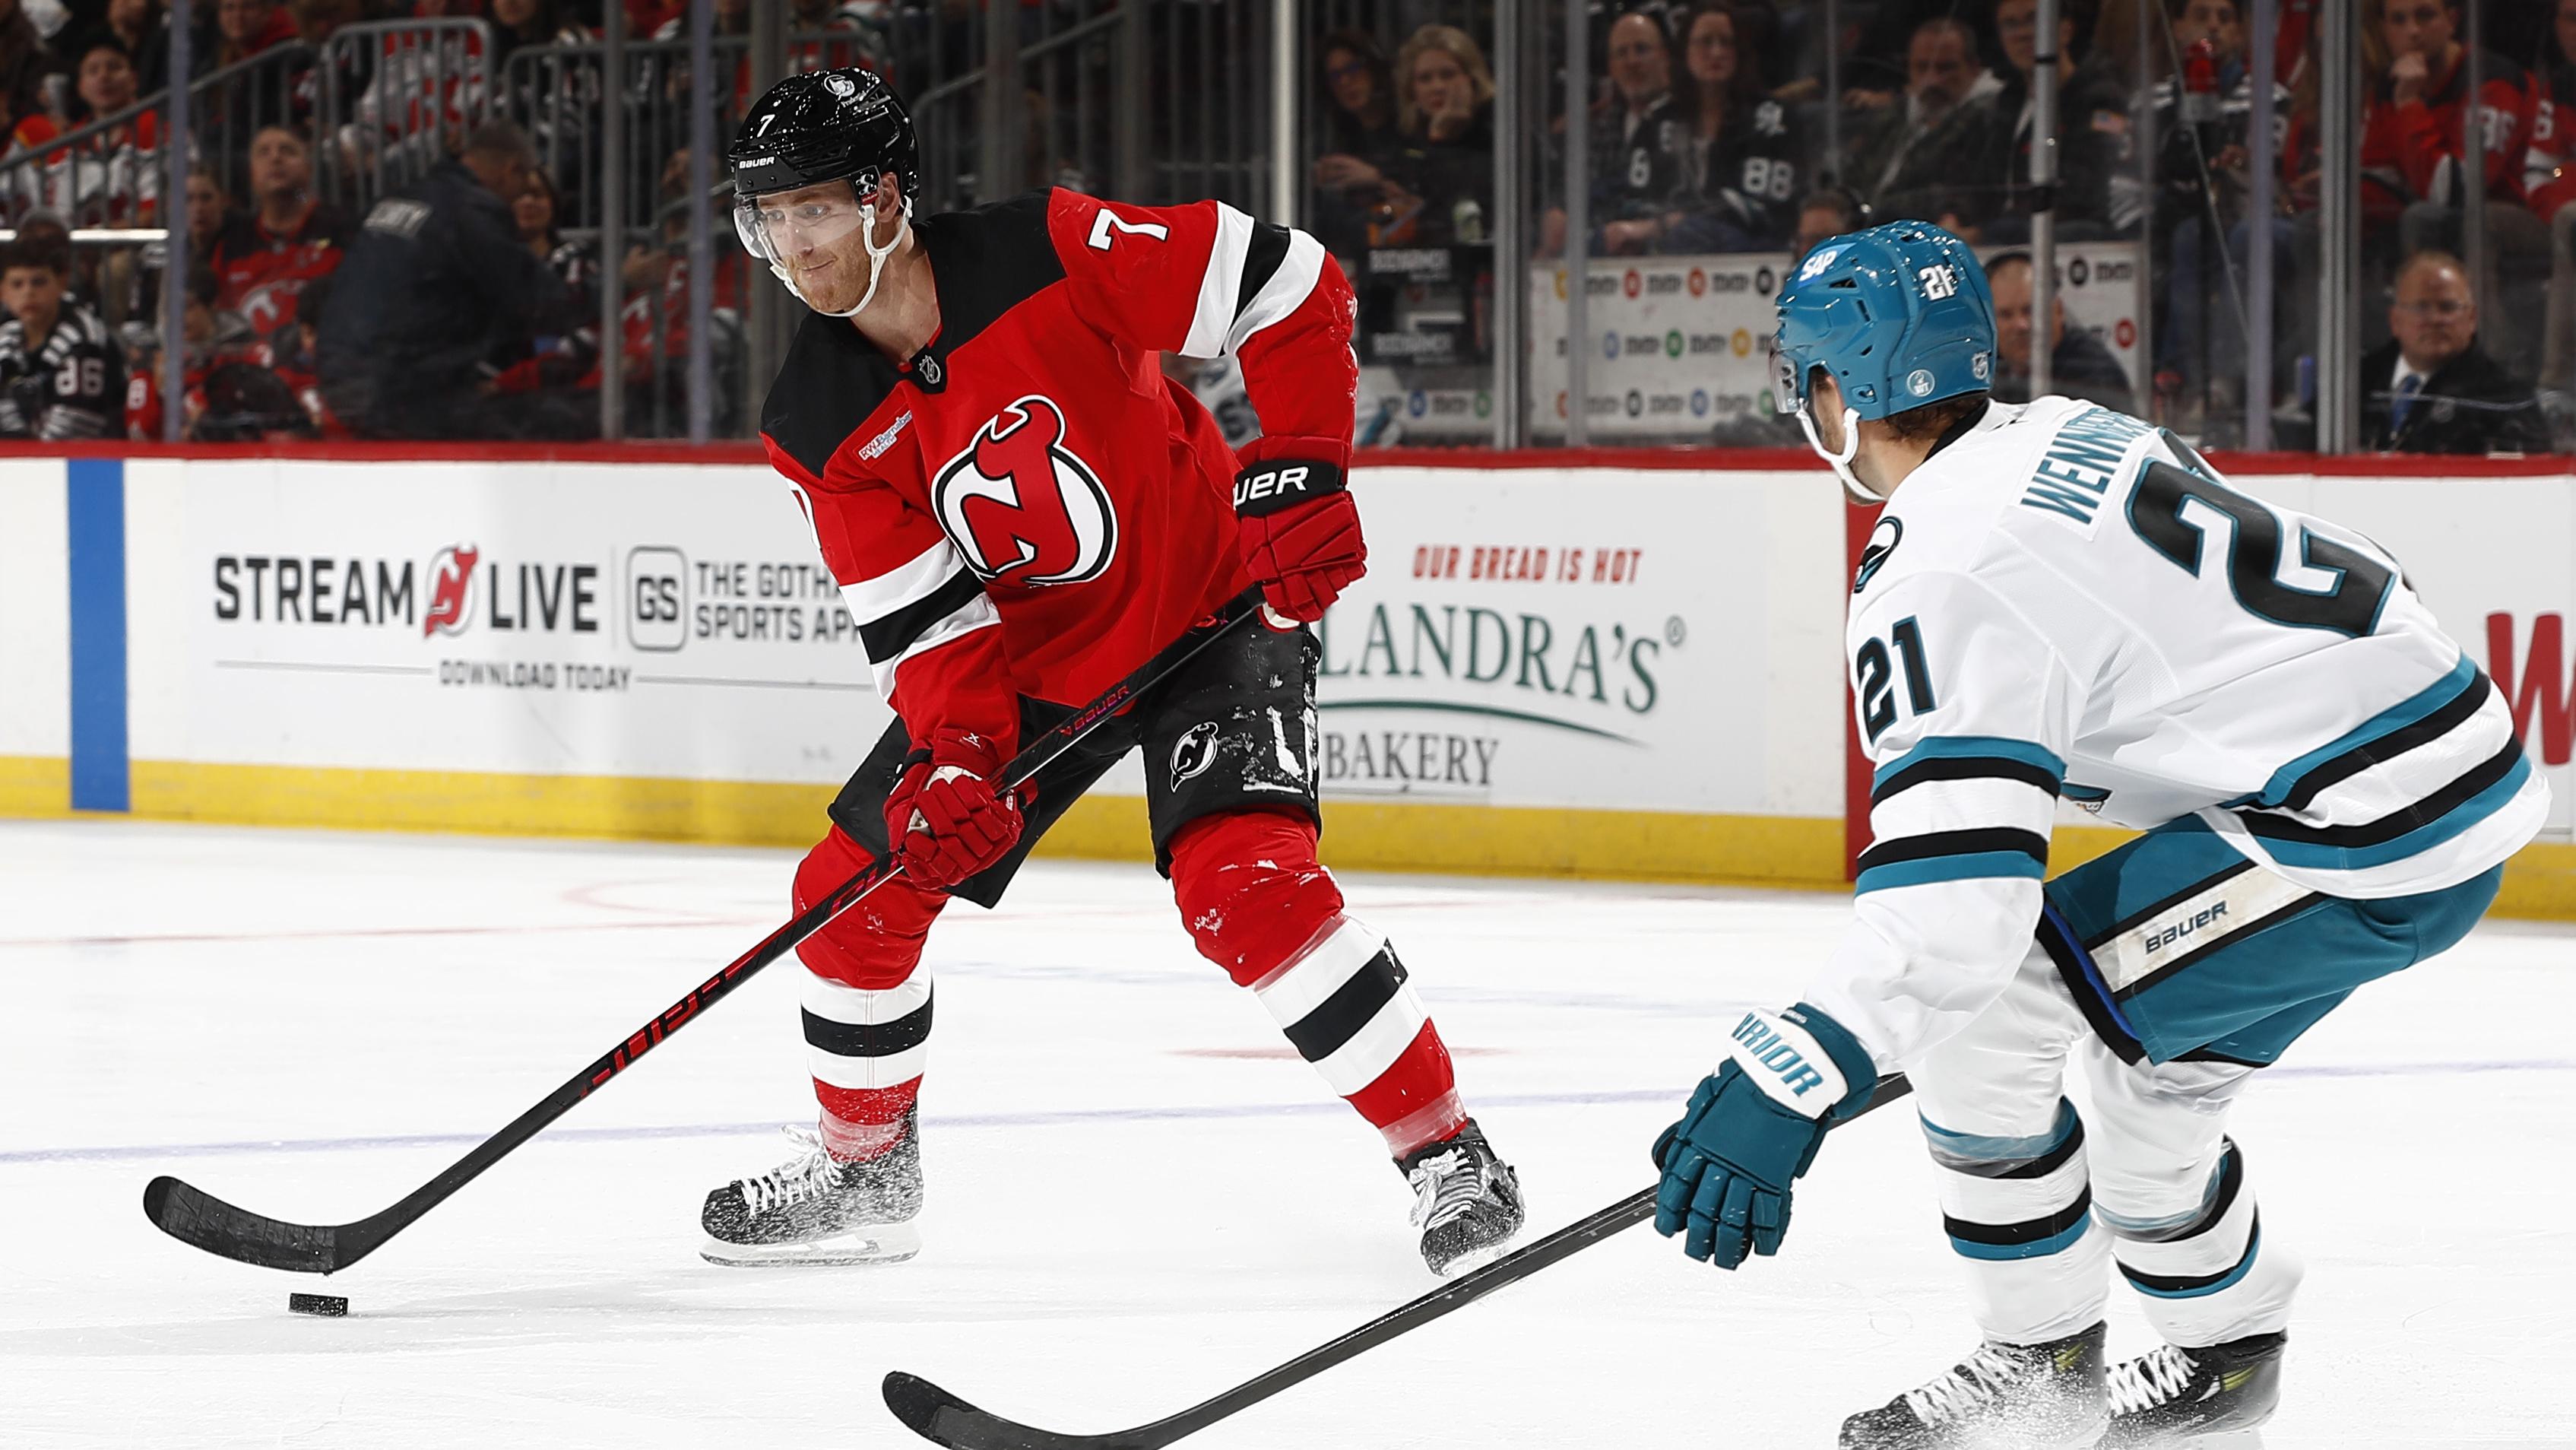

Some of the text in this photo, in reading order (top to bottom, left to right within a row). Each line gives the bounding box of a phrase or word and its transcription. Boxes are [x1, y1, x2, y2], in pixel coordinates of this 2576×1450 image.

[757, 114, 775, 138] 7
[1087, 207, 1169, 251] 7
[1798, 251, 1836, 281] SAP
[1918, 265, 1958, 301] 21
[1233, 466, 1308, 511] UER
[2124, 427, 2398, 640] 2
[695, 563, 749, 598] THE
[1413, 545, 1642, 583] OUR BREAD IS HOT
[216, 557, 598, 631] STREAM LIVE
[636, 576, 679, 621] GS
[695, 605, 803, 641] SPORTS
[440, 659, 630, 692] DOWNLOAD TODAY
[1318, 603, 1660, 713] LANDRA'S
[1856, 614, 1938, 747] 21
[1325, 732, 1499, 786] BAKERY
[2145, 900, 2229, 955] BAUER
